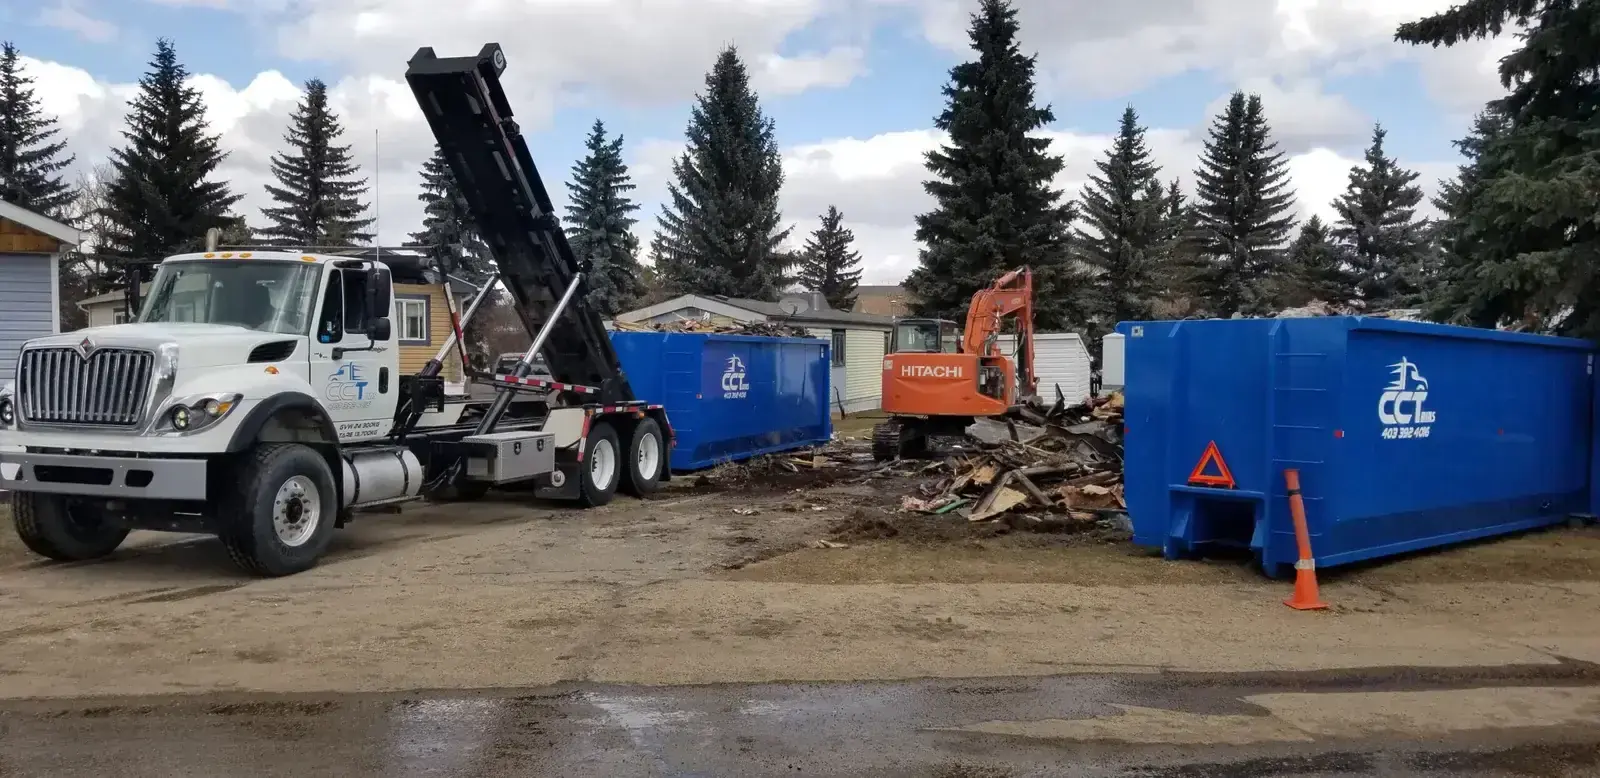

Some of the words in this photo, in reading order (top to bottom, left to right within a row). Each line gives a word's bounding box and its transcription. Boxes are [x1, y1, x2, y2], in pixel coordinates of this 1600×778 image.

[901, 365, 963, 378] HITACHI
[326, 381, 369, 401] CCT
[722, 372, 746, 391] CCT
[1378, 391, 1429, 424] CCT
[1382, 427, 1398, 439] 403
[1398, 426, 1414, 439] 392
